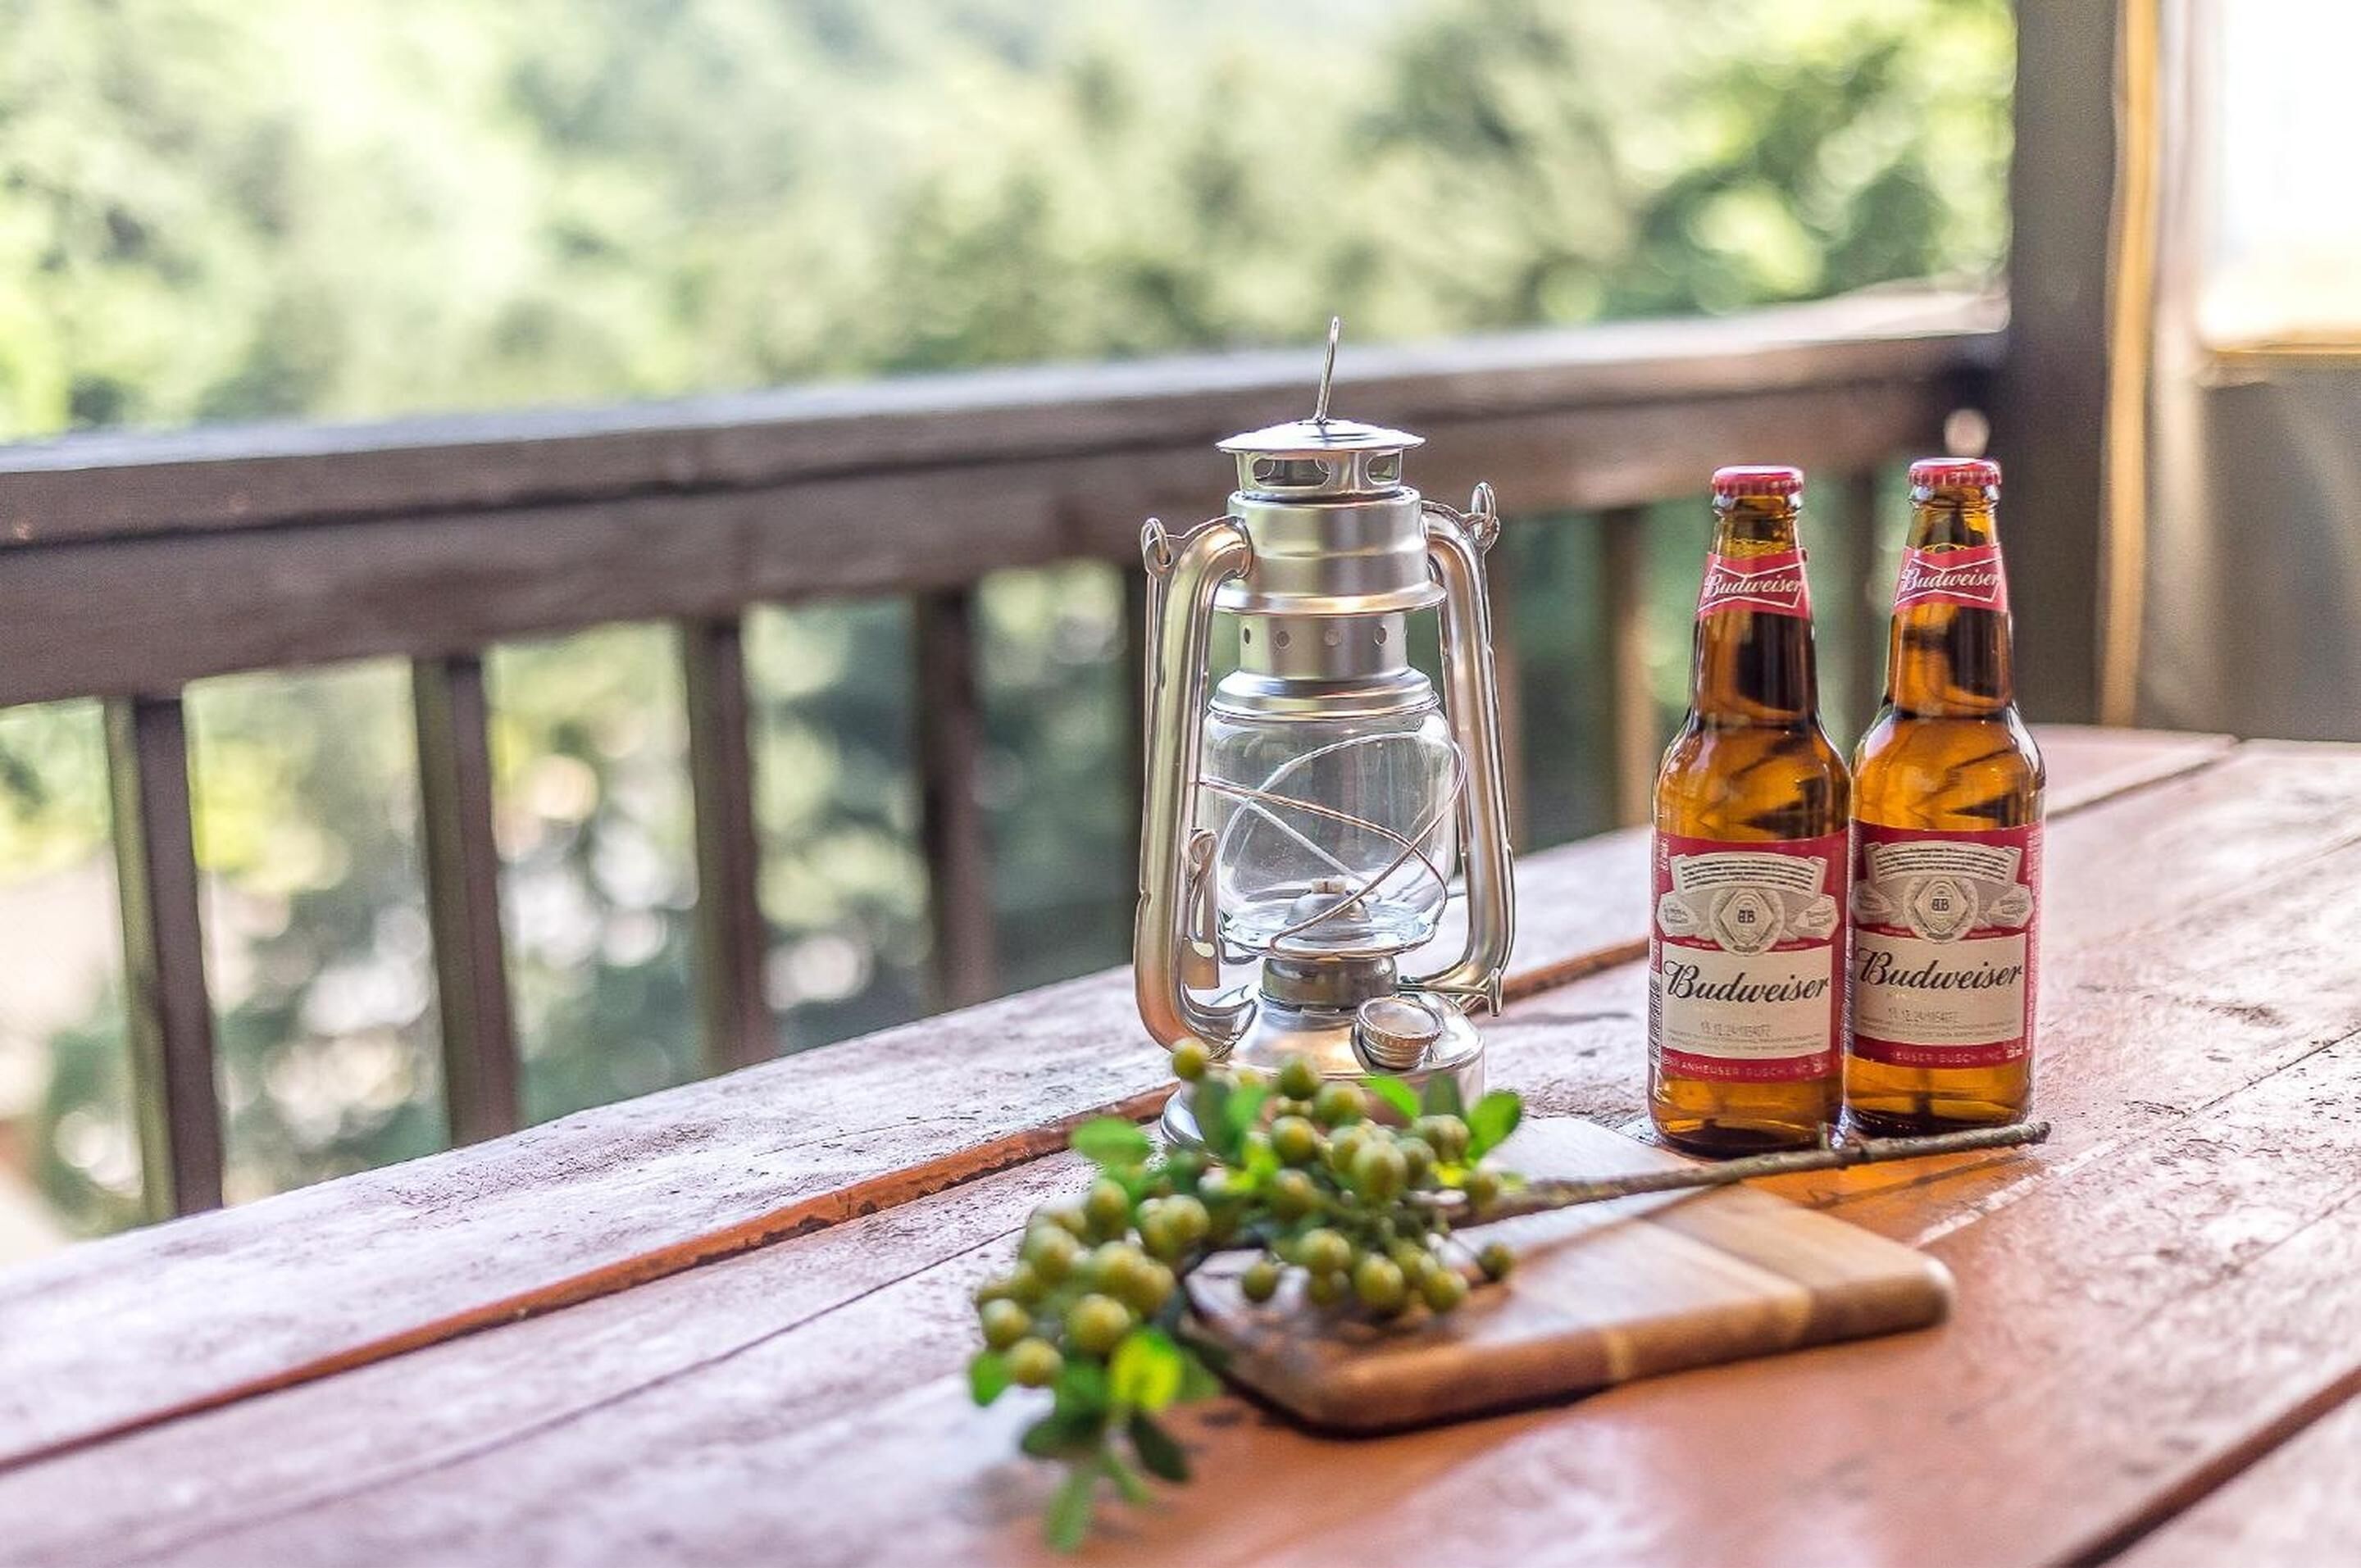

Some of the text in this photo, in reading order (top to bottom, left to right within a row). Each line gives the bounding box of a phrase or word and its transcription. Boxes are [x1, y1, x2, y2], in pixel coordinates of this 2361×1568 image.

[1704, 574, 1803, 598] Budweiser
[1900, 567, 2000, 592] Budweiser
[1663, 960, 1830, 1002] Budweiser
[1857, 948, 2022, 989] Budweiser
